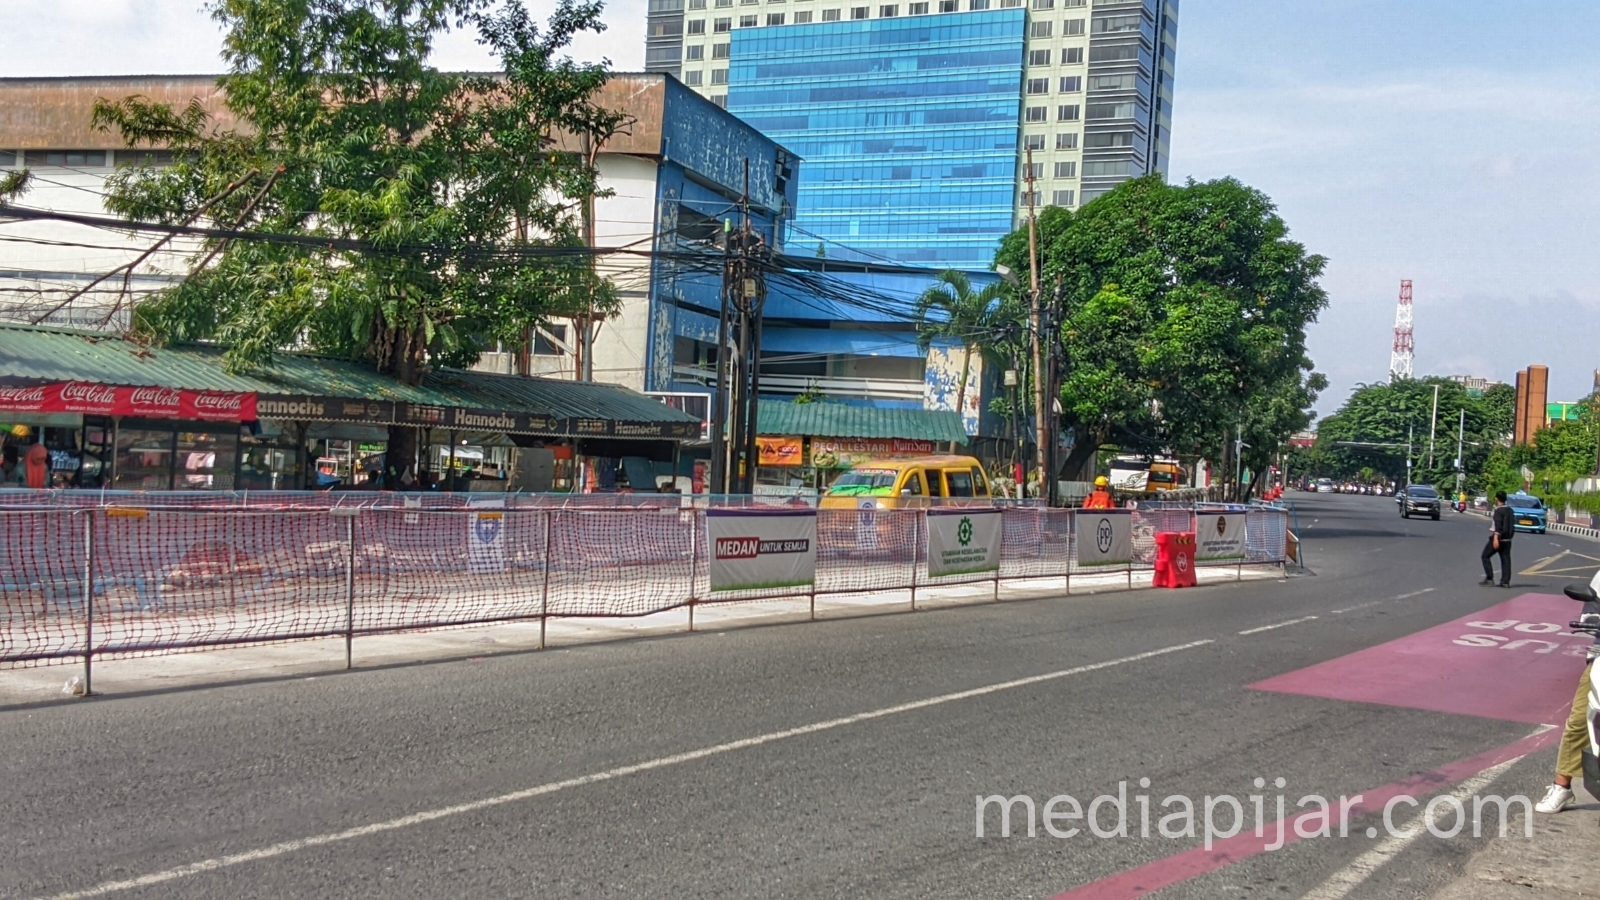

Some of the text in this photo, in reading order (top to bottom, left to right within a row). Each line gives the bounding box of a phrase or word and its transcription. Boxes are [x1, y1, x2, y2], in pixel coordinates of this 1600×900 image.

[60, 381, 117, 403] Coca-Cola
[130, 387, 182, 406] Coca-Cola
[256, 398, 324, 415] annochs
[455, 408, 515, 428] Hannochs
[614, 421, 662, 435] Hannochs
[813, 442, 889, 452] PECAL LESTARI
[717, 540, 807, 556] MEDAN UNTUK SEMUA
